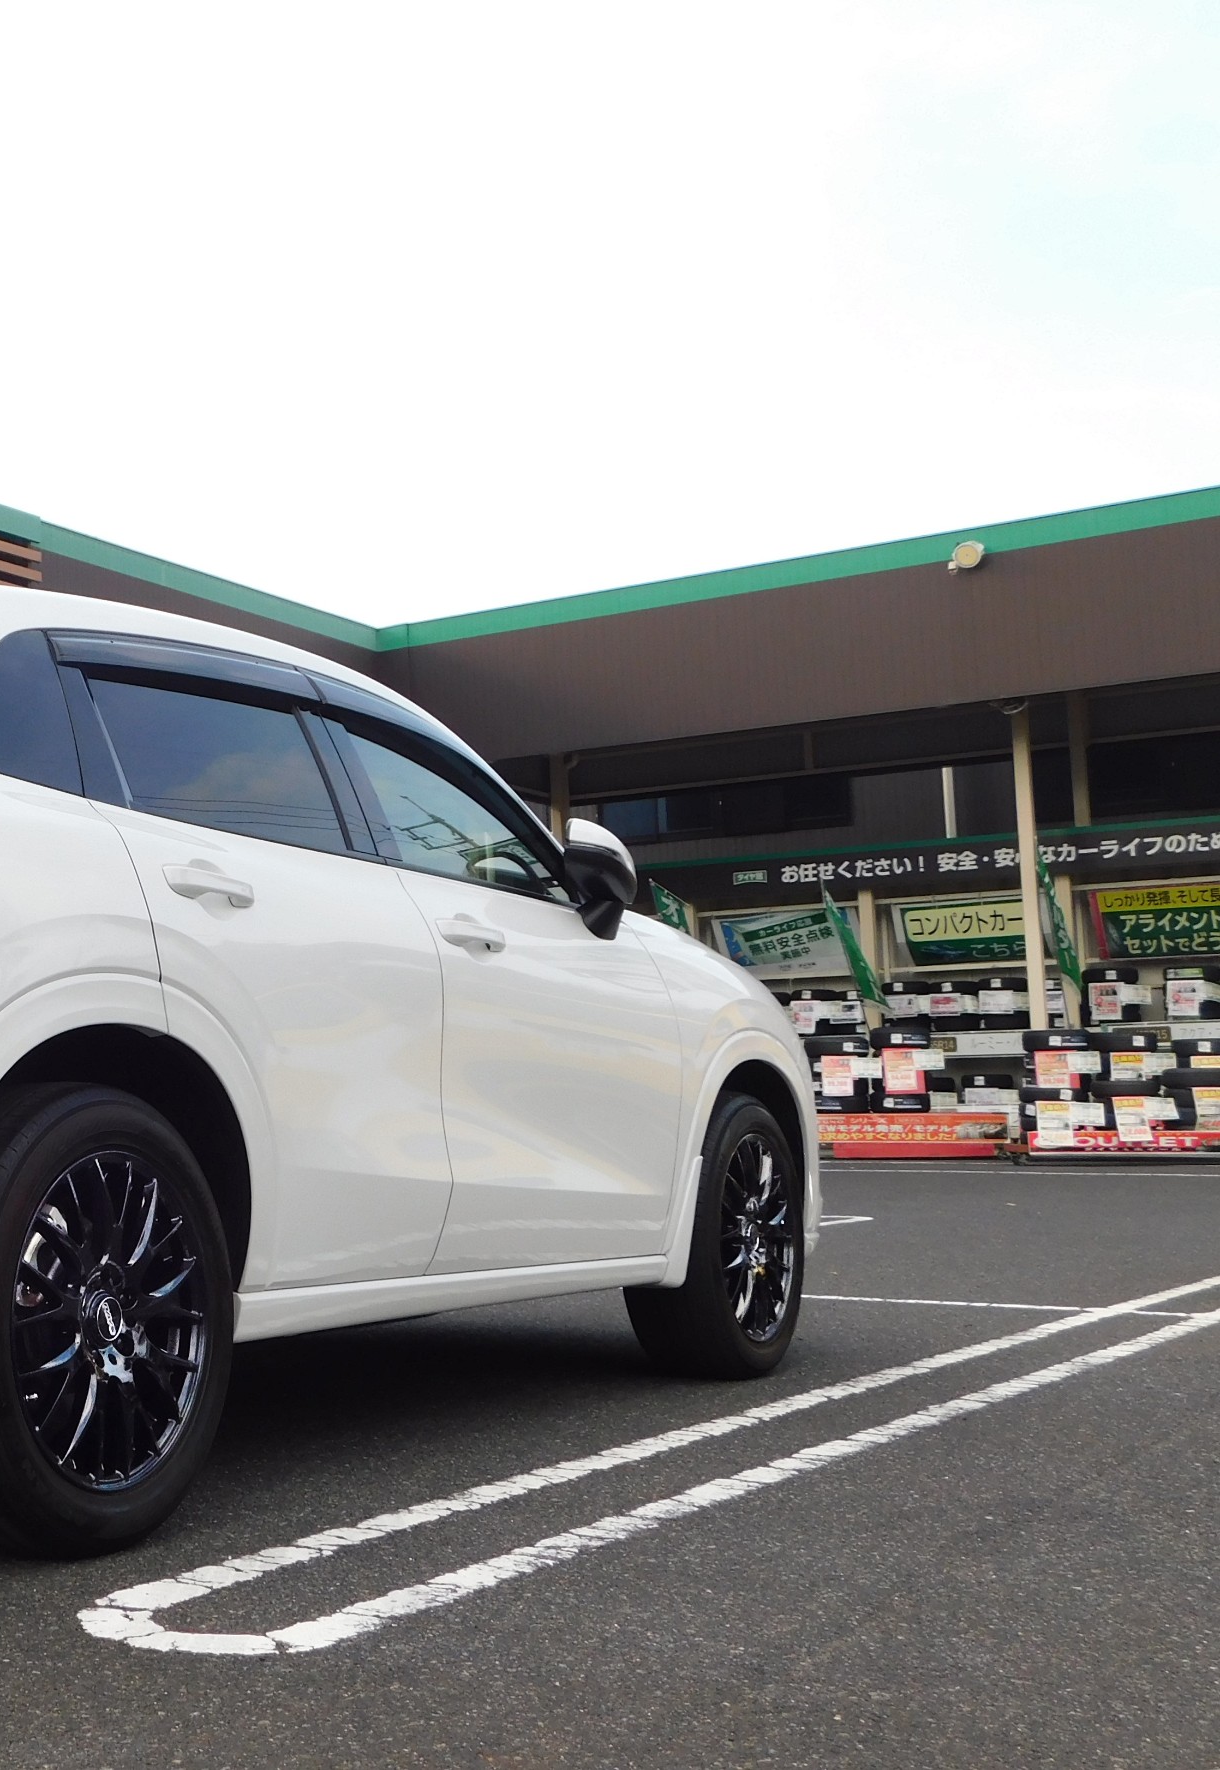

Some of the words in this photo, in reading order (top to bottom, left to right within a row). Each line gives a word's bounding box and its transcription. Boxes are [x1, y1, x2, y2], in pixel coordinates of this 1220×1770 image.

[937, 833, 1220, 872] 安全・安なカーライフのため
[909, 910, 1022, 935] コンパクトカー
[749, 926, 834, 956] 無料安全点検
